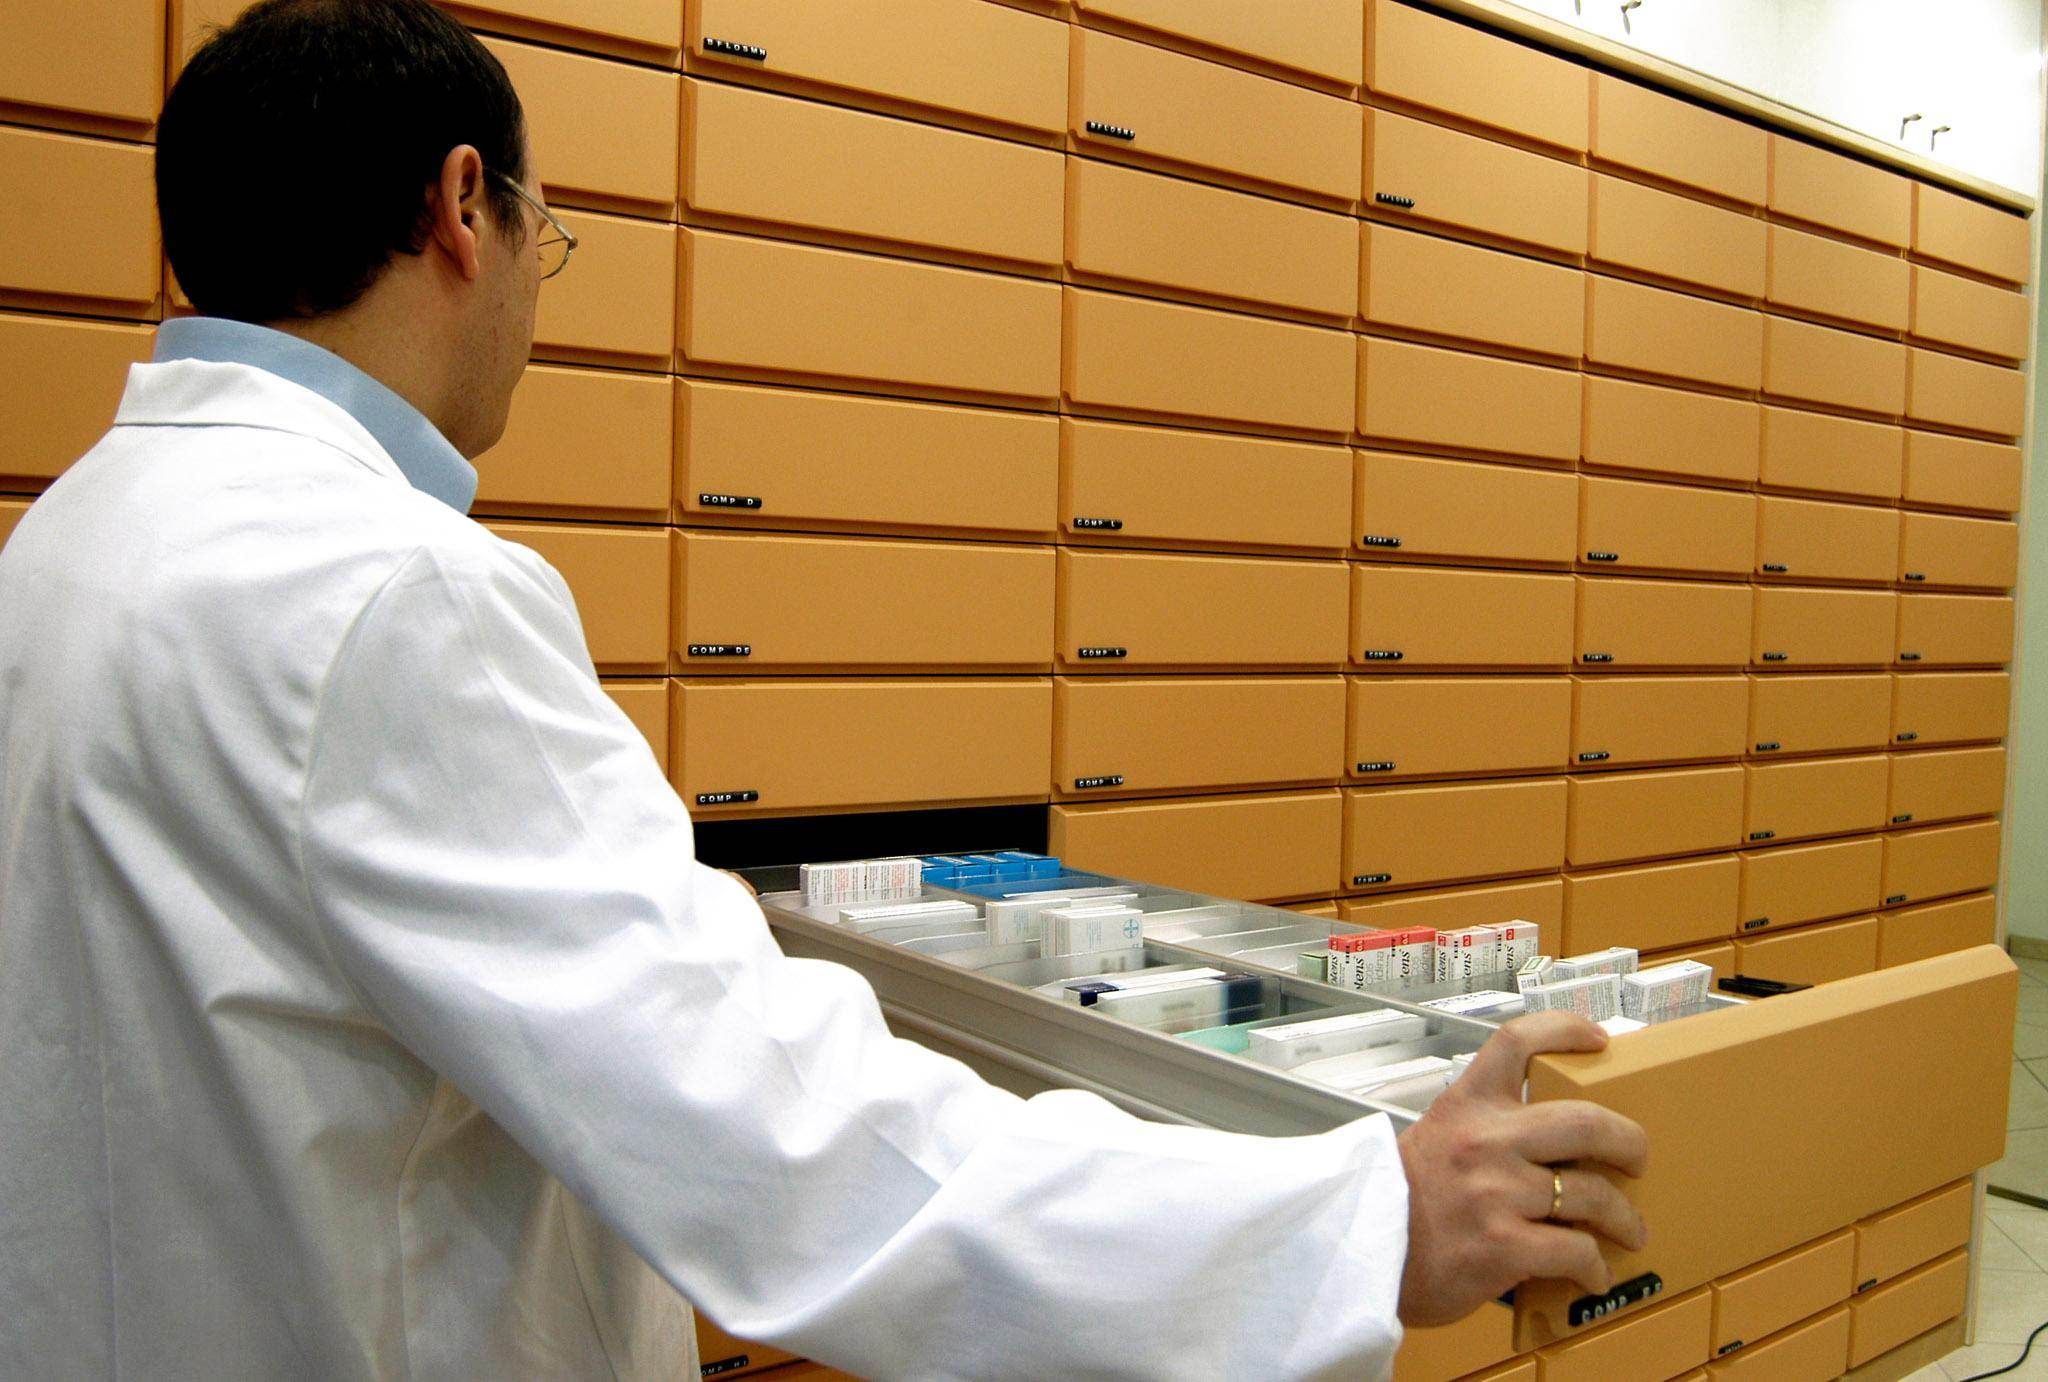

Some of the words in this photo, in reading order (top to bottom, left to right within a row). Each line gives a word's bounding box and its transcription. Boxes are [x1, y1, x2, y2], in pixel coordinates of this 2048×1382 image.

[703, 495, 736, 505] COMP
[1078, 519, 1103, 527] COMP
[691, 645, 724, 655] COMP
[1083, 649, 1107, 657] COMP
[1080, 778, 1104, 787] COMP
[700, 795, 731, 804] COMP
[1582, 1294, 1627, 1323] COMP
